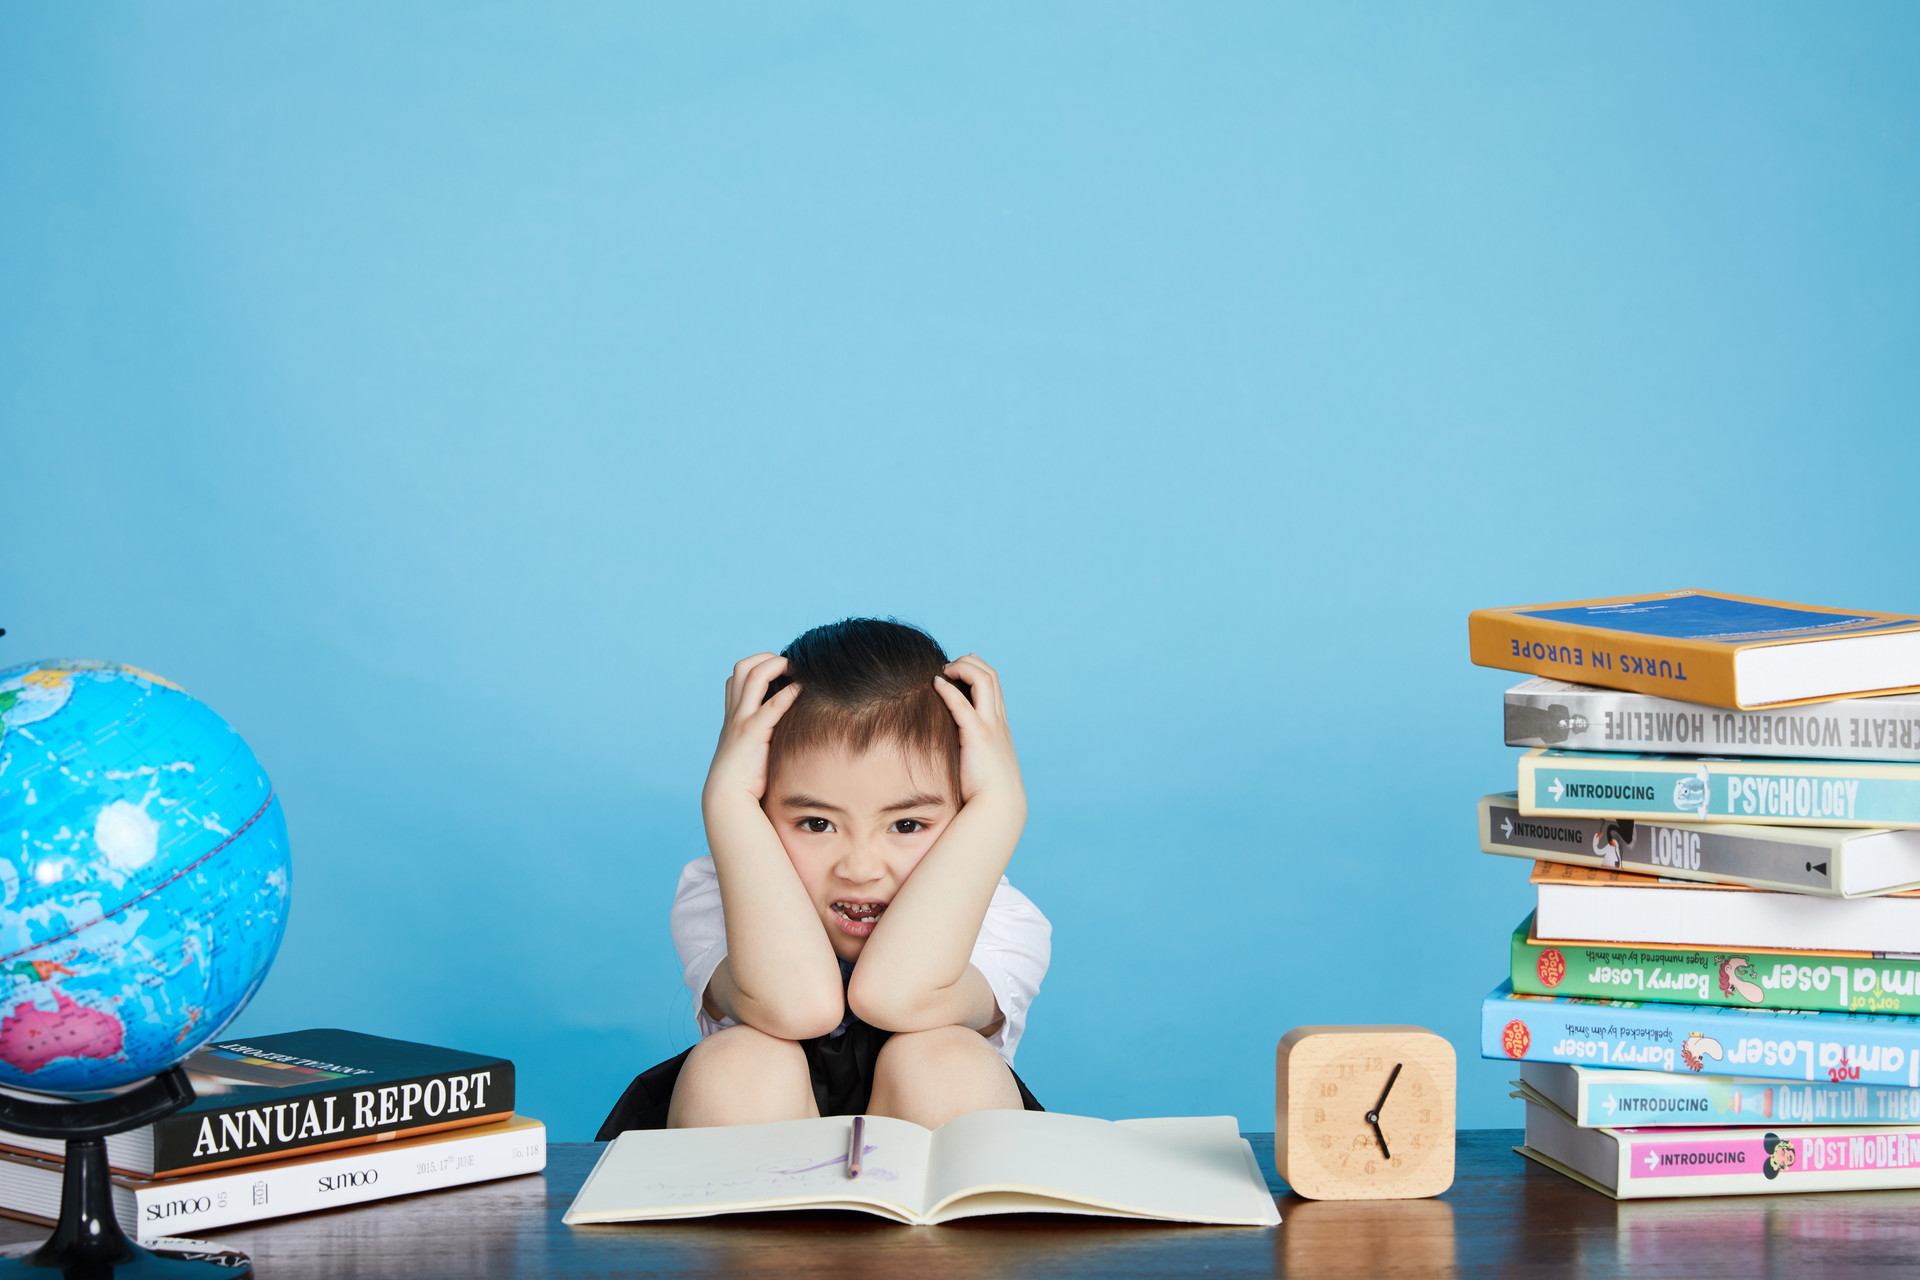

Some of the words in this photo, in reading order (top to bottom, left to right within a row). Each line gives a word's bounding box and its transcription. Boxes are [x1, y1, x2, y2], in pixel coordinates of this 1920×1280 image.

[1511, 639, 1583, 666] EUROPE
[1592, 650, 1612, 670] IN
[1620, 654, 1687, 681] TURKS
[1605, 711, 1704, 743] HOMELIFE
[1712, 714, 1842, 748] WONDERFUL
[1565, 783, 1655, 801] INTRODUCING
[1727, 776, 1859, 818] PSYCHOLOGY
[1514, 822, 1582, 844] INTRODUCING
[1650, 825, 1701, 871] LOGIC
[1586, 950, 1610, 964] Smith
[1612, 953, 1628, 963] Jim
[1628, 952, 1638, 964] by
[1641, 952, 1684, 964] numbered
[1686, 955, 1709, 969] Pages
[1548, 949, 1558, 985] Jolly
[1588, 966, 1644, 990] Loser
[1647, 968, 1710, 999] Barry
[1762, 963, 1848, 1007] Loser
[1853, 967, 1877, 992] a
[1849, 996, 1866, 1011] of
[1868, 998, 1900, 1012] sort
[1565, 1024, 1590, 1037] Smith
[1591, 1026, 1607, 1035] Jim
[1608, 1024, 1618, 1035] by
[1620, 1027, 1673, 1043] Spellchecked
[1513, 1022, 1523, 1058] Jolly
[218, 1043, 296, 1063] REPORT
[1553, 1039, 1609, 1063] Loser
[1611, 1041, 1675, 1071] Barry
[1727, 1038, 1814, 1081] Loser
[1819, 1042, 1842, 1067] a
[1848, 1044, 1904, 1072] am
[1337, 1064, 1355, 1081] 11
[1365, 1057, 1383, 1072] 12
[1909, 1049, 1919, 1088] I
[1828, 1066, 1860, 1084] not
[1318, 1083, 1339, 1098] 10
[1411, 1083, 1423, 1098] 2
[1618, 1097, 1709, 1113] INTRODUCING
[1778, 1085, 1868, 1122] QUANTUM
[192, 1095, 345, 1158] ANNUAL
[352, 1071, 492, 1131] REPORT
[1314, 1107, 1326, 1123] 9
[1419, 1109, 1432, 1124] 3
[1320, 1134, 1332, 1149] 8
[1410, 1134, 1422, 1149] 4
[526, 1144, 540, 1157] 118
[1660, 1150, 1746, 1167] INTRODUCING
[1339, 1154, 1350, 1168] 7
[1364, 1160, 1376, 1175] 6
[1391, 1153, 1402, 1168] 5
